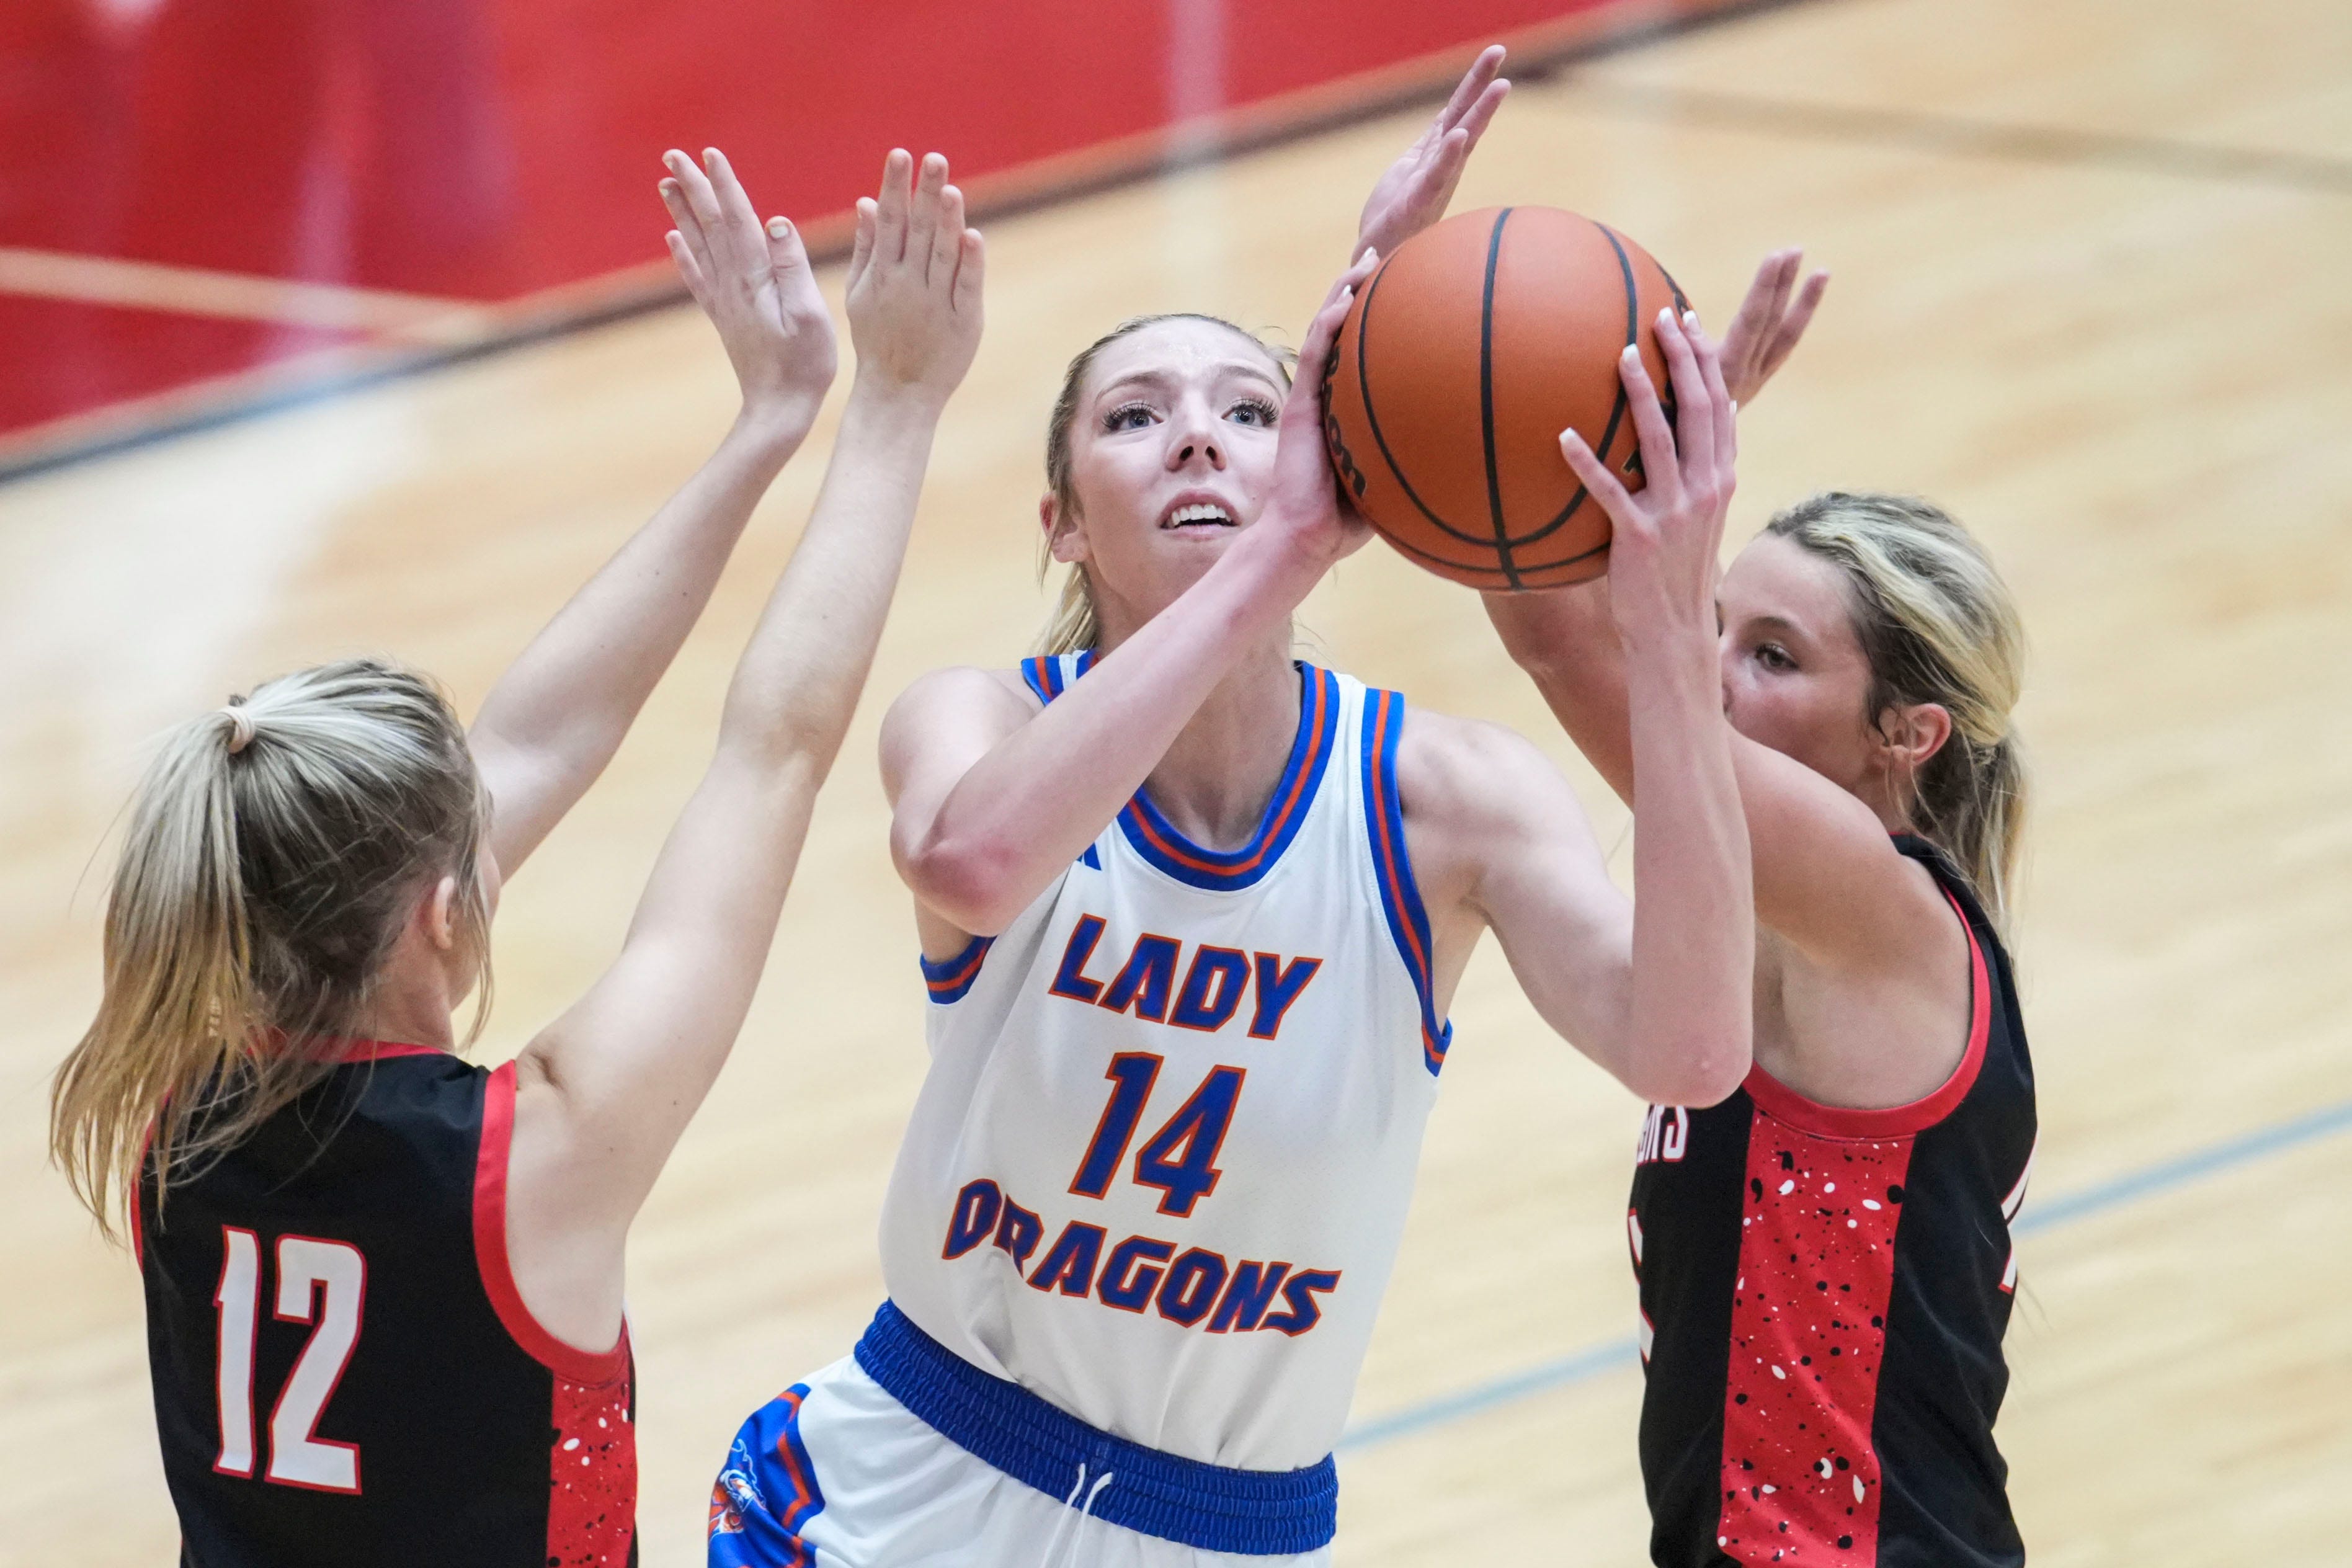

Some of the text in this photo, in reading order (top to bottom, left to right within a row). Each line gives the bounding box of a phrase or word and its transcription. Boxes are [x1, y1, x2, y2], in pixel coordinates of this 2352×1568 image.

[1048, 913, 1324, 1040] LADY
[1067, 1051, 1247, 1218] 14
[942, 1178, 1343, 1337] DRAGONS
[212, 1224, 367, 1495] 12
